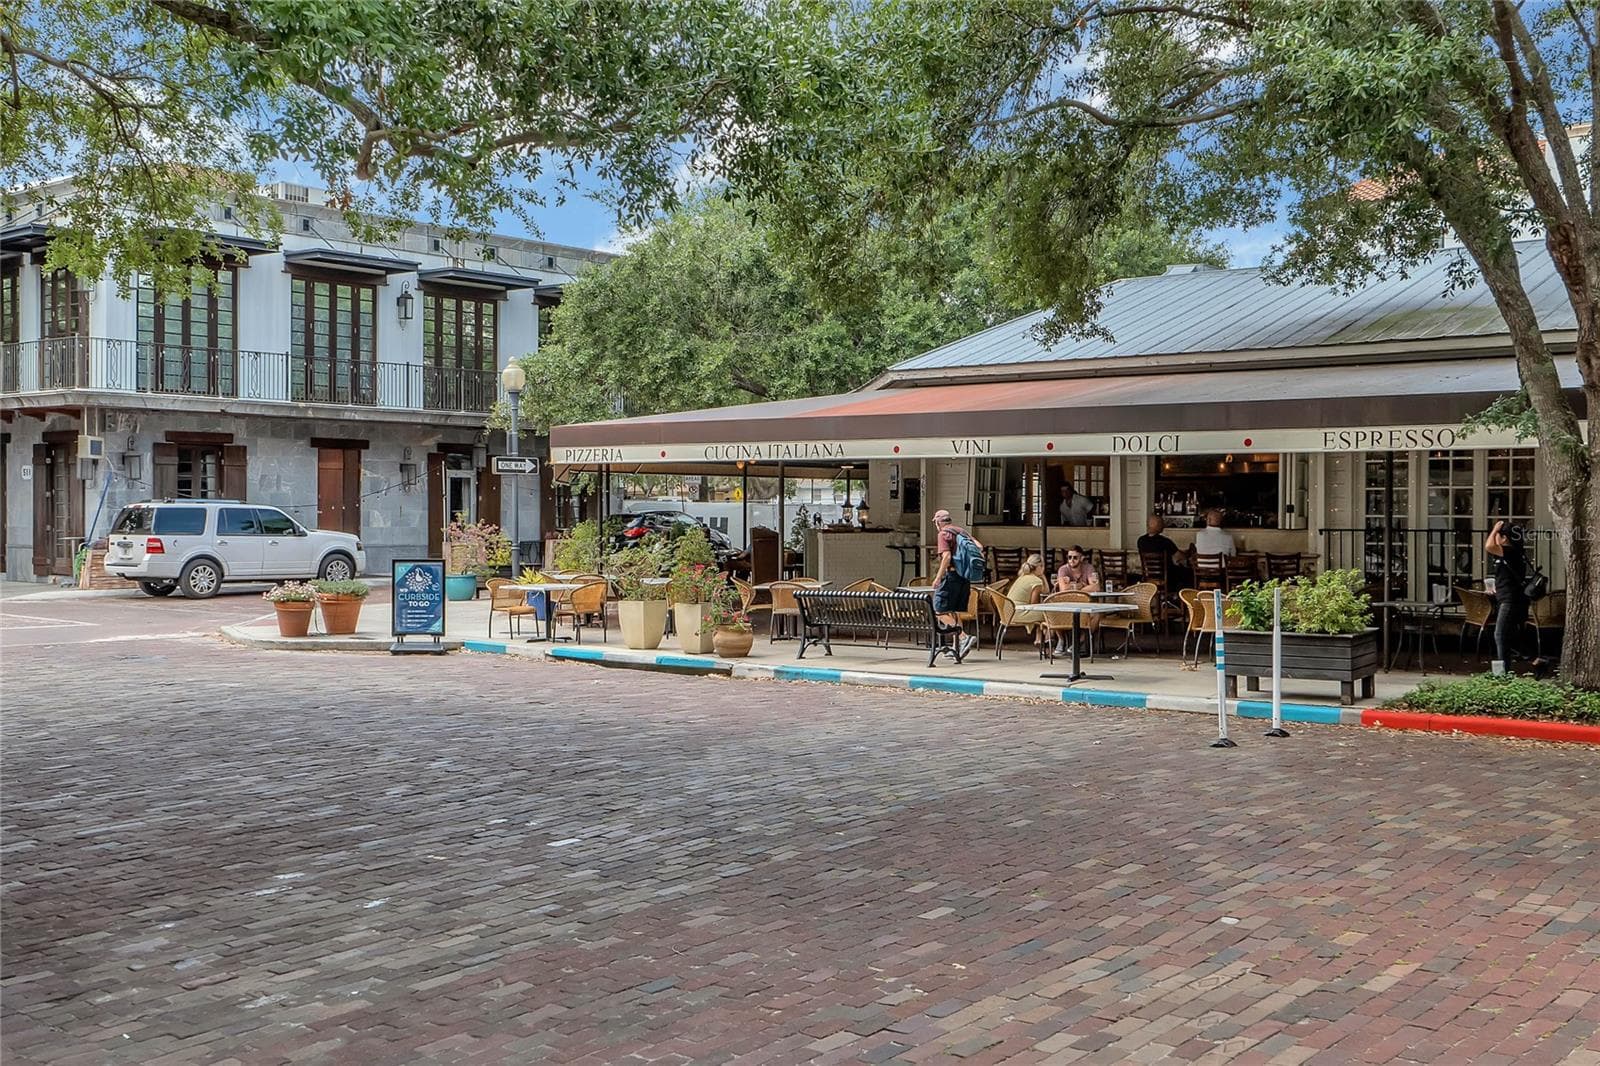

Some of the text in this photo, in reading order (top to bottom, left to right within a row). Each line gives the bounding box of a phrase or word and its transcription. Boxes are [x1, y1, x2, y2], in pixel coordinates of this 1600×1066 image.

[951, 439, 992, 455] VINI
[1112, 434, 1181, 453] DOLCI
[1322, 428, 1456, 450] ESPRESSO
[565, 448, 624, 462] PIZZERIA
[704, 443, 846, 460] CUCINA ITALIANA
[398, 593, 440, 601] CURBSIDE
